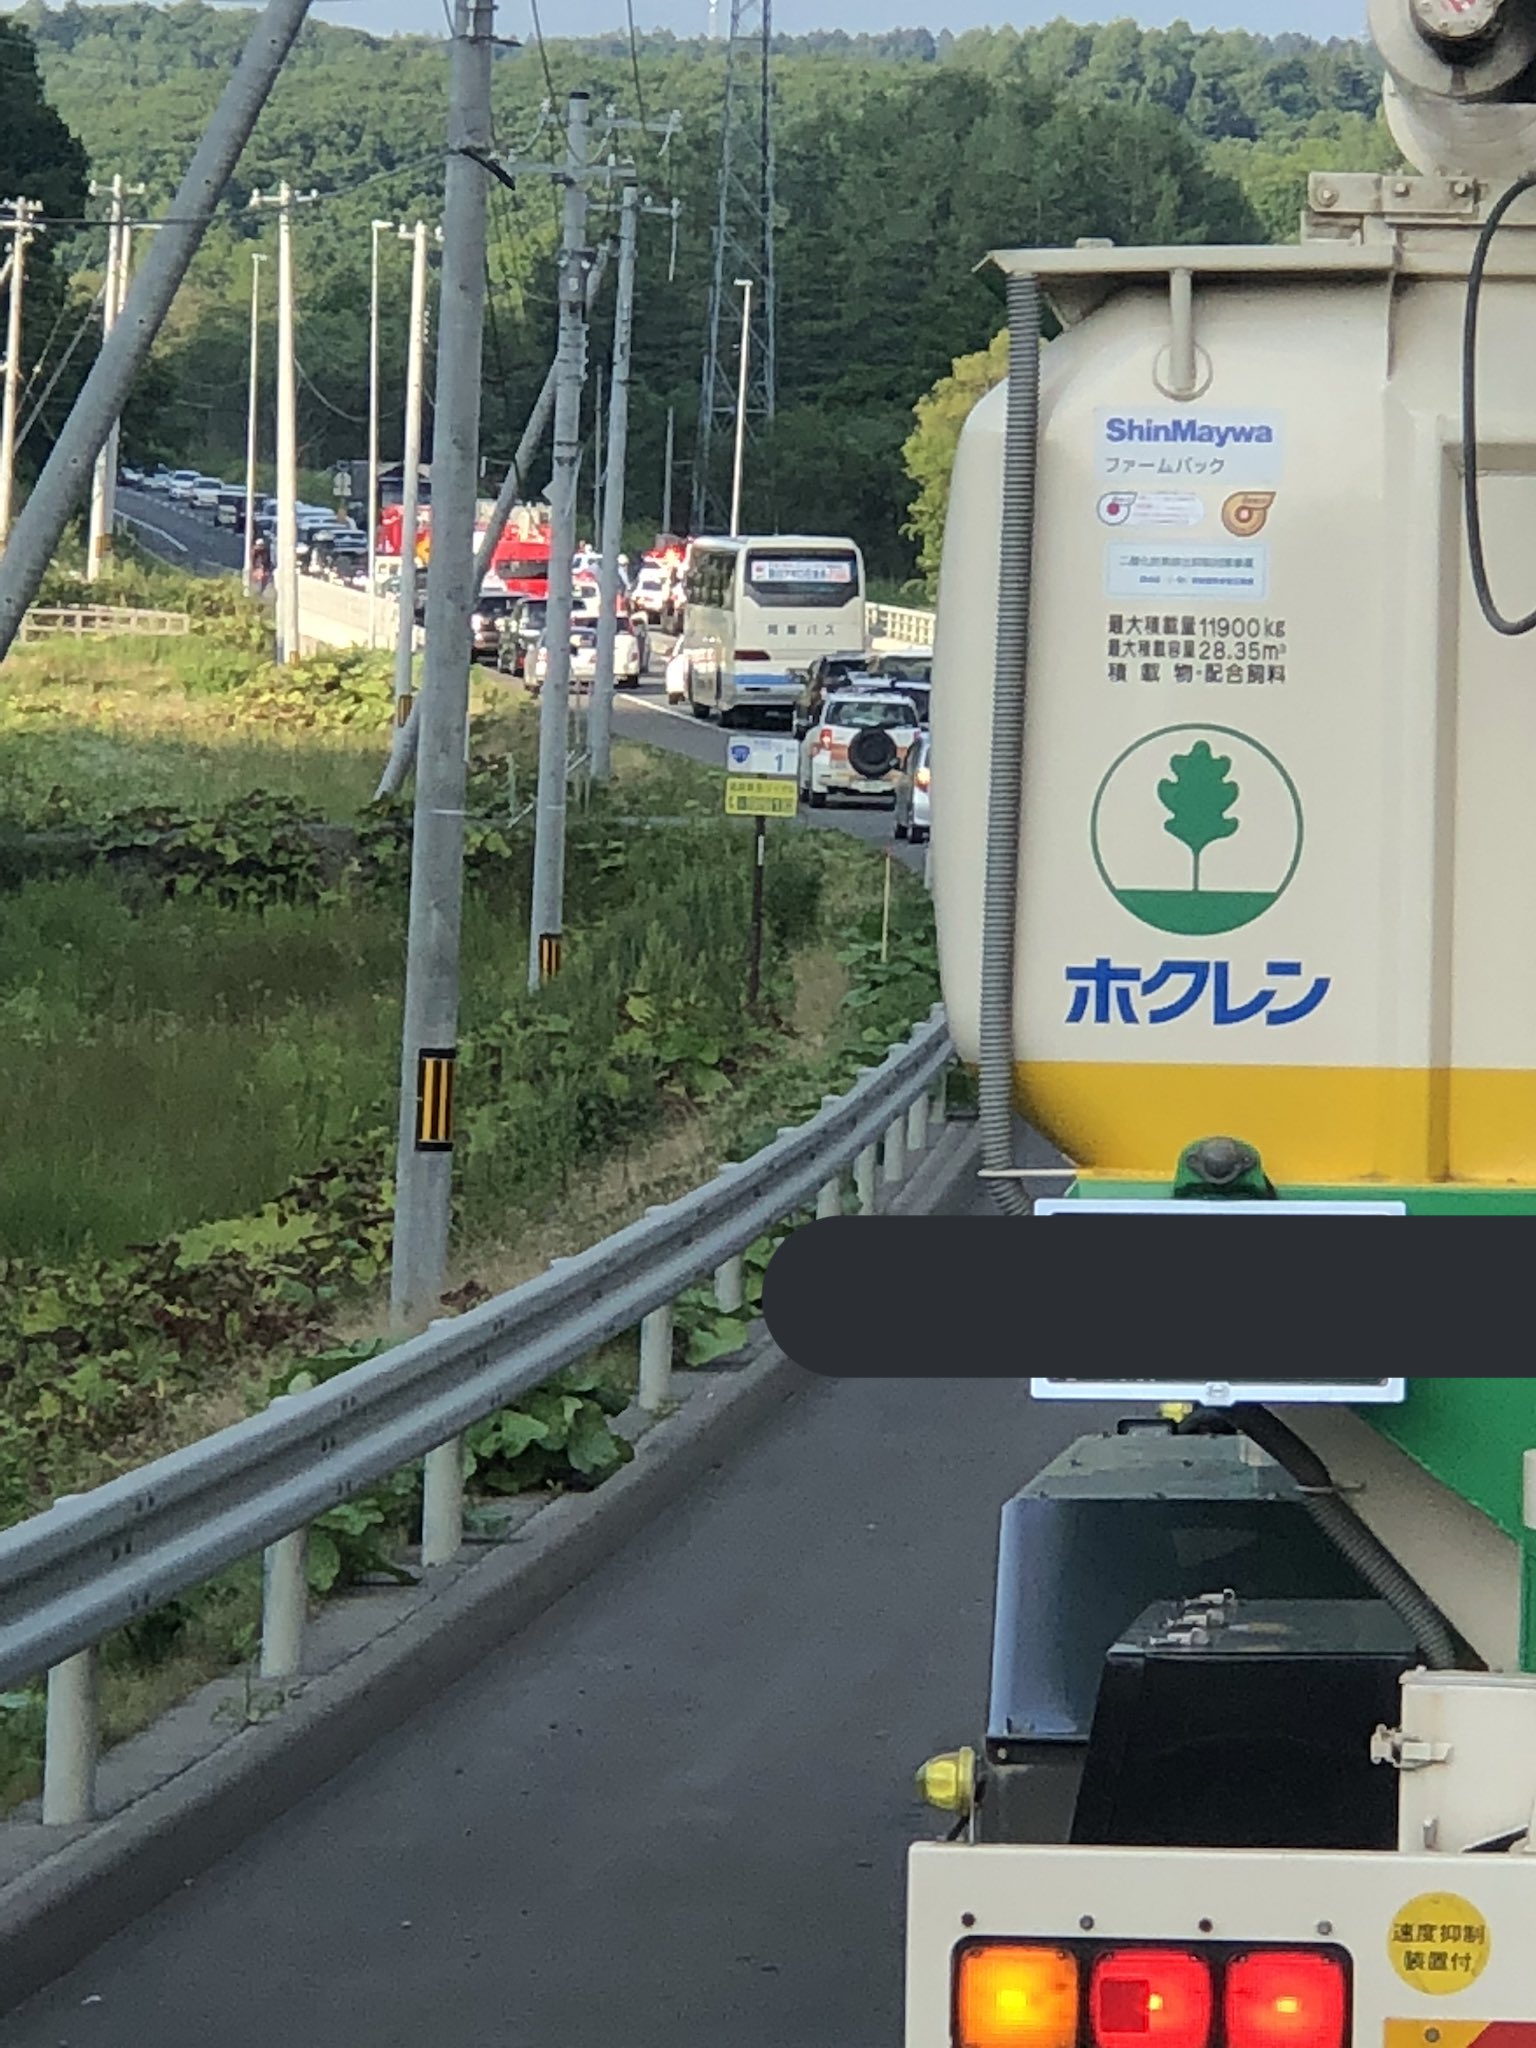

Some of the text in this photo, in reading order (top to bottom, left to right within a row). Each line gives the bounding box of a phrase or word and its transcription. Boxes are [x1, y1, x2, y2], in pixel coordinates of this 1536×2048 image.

[1106, 418, 1273, 447] ShinMaywa
[1065, 958, 1331, 1026] ホクレン
[1392, 1922, 1486, 1945] 速度抑制
[1404, 1950, 1472, 1972] 装置付
